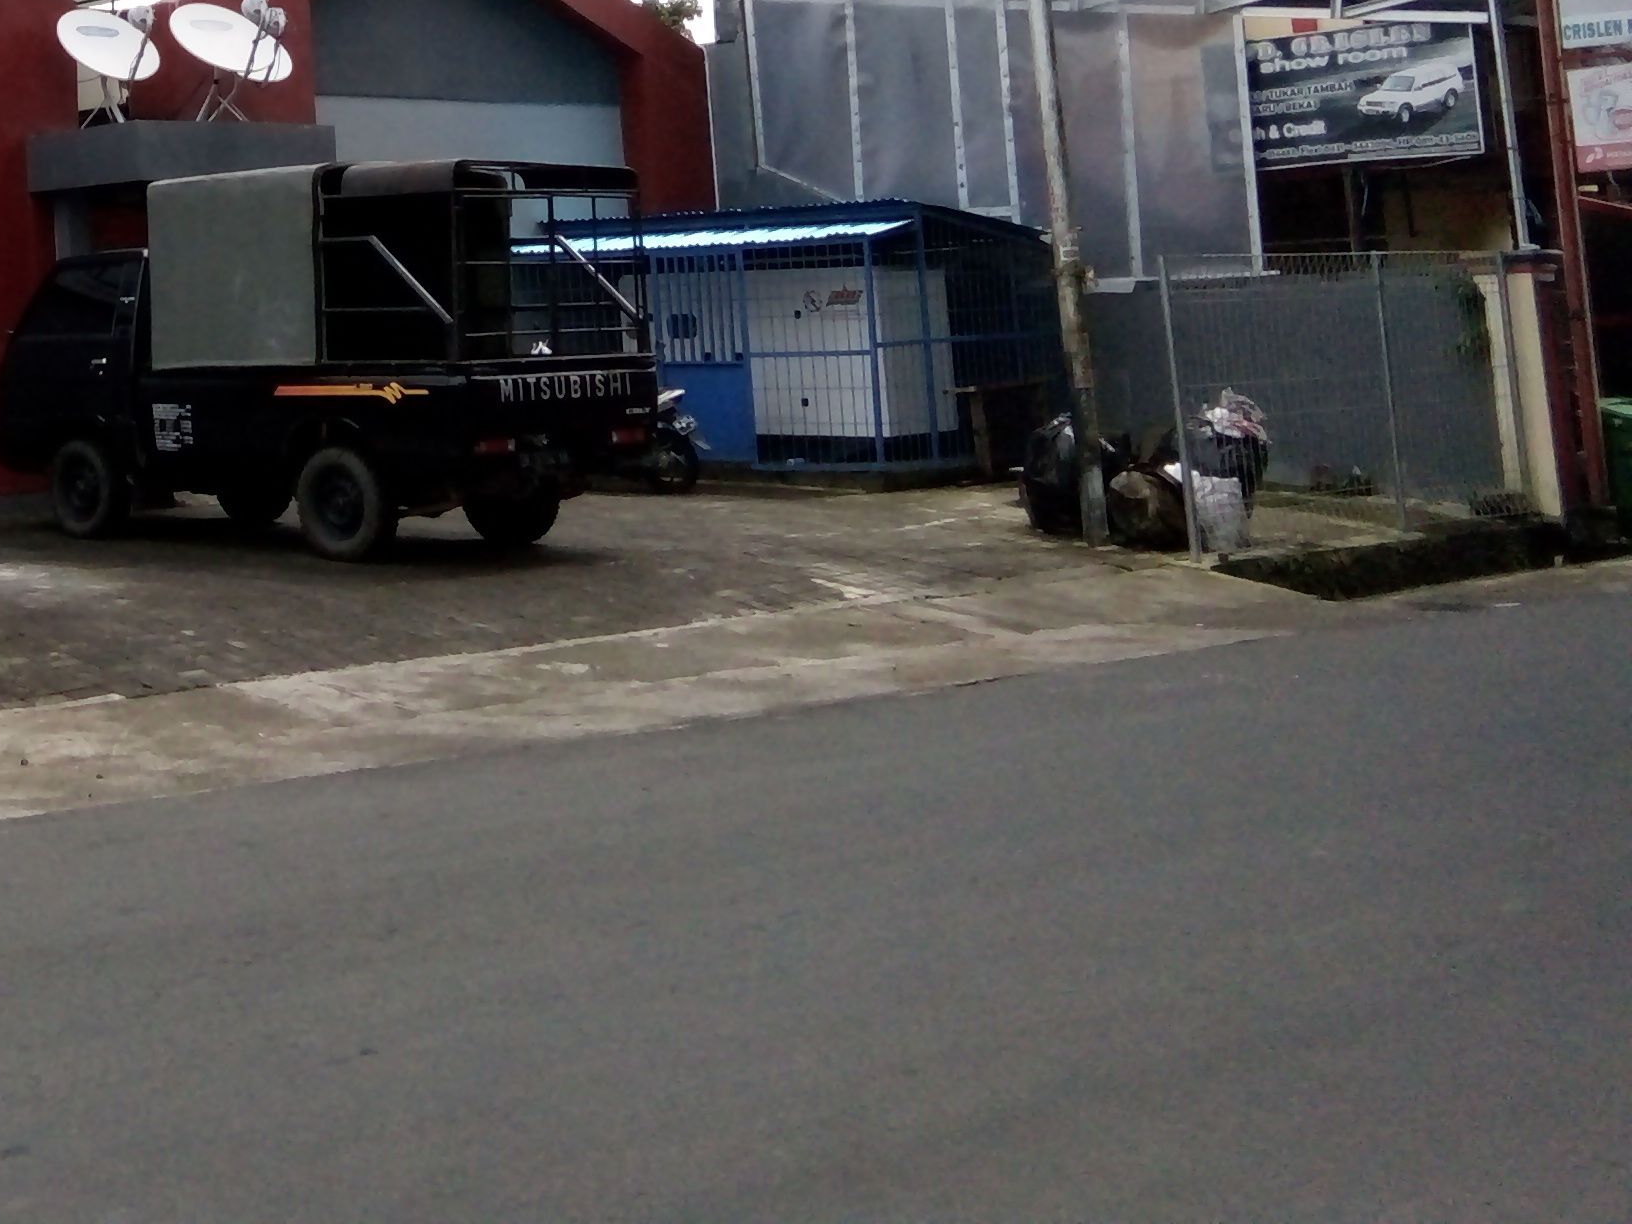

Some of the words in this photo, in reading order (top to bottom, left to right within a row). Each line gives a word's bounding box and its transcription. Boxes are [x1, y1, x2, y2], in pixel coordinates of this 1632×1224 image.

[1563, 19, 1623, 41] CRISLEN
[1260, 56, 1330, 74] show
[1337, 47, 1409, 66] room
[1307, 81, 1355, 96] TAMBAH
[499, 373, 632, 403] MITSUBISHI
